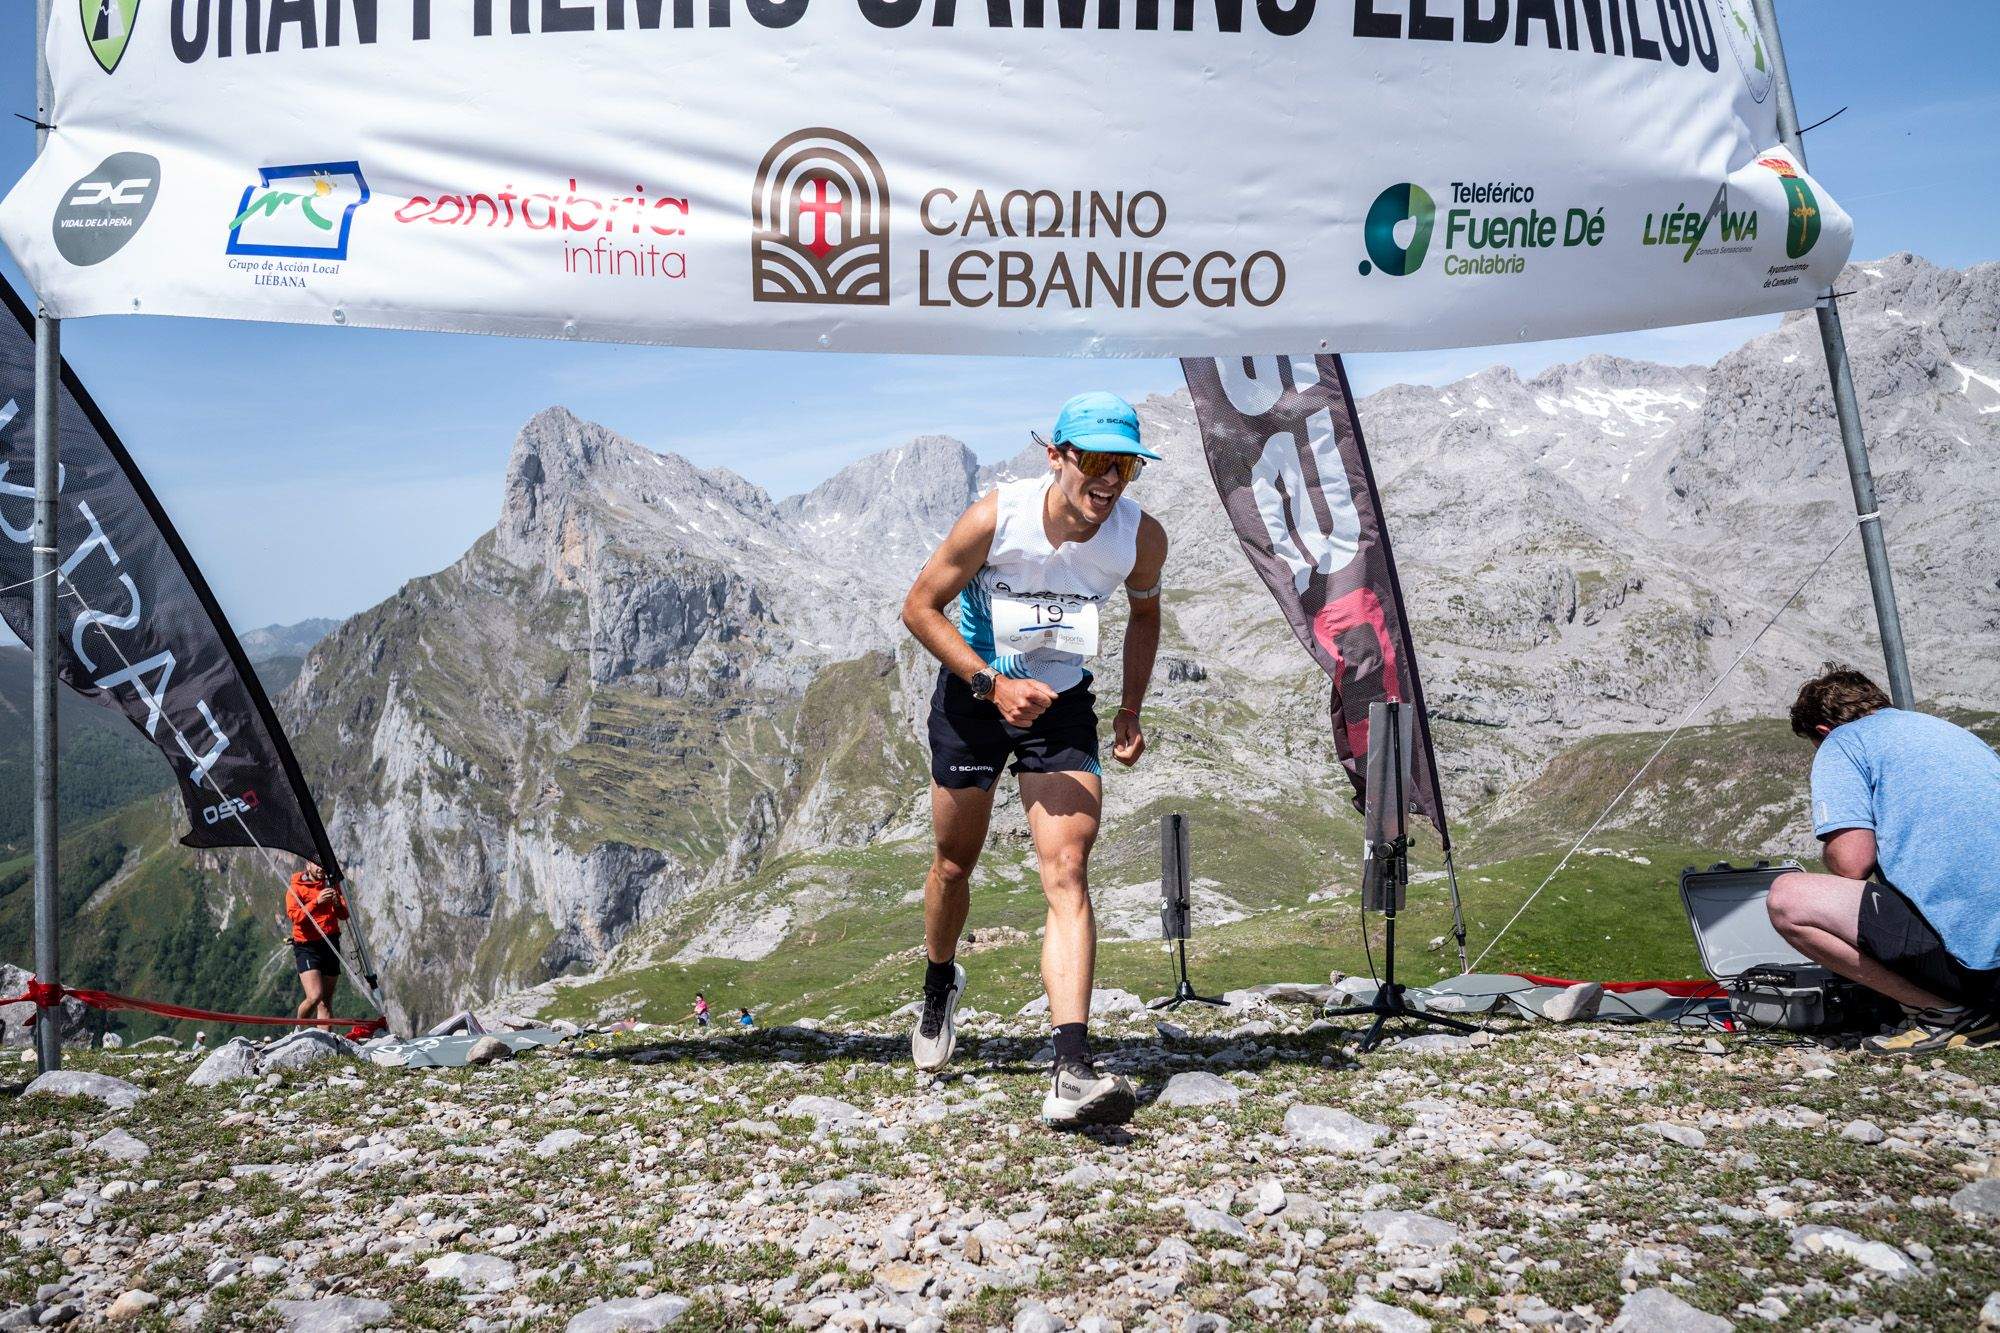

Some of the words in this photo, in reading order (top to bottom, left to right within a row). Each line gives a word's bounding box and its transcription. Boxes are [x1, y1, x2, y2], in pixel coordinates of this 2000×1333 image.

[1450, 181, 1535, 204] Teleférico
[394, 178, 689, 236] cantabria
[919, 187, 1167, 239] CAMINO
[61, 218, 85, 228] VIDAL
[85, 218, 96, 227] DE
[96, 218, 108, 227] LA
[108, 216, 133, 227] PEÑA
[1445, 208, 1557, 250] Fuente
[1563, 206, 1606, 247] Dé
[228, 259, 260, 271] Grupo
[261, 260, 274, 271] de
[275, 261, 310, 273] Acción
[312, 263, 340, 275] Local
[563, 236, 687, 279] infinita
[1444, 253, 1526, 276] Cantabria
[254, 272, 307, 288] LIÉBANA
[918, 249, 1287, 309] LEBANIEGO
[1767, 263, 1809, 277] Ayuntamiento
[1763, 279, 1771, 288] de
[1771, 276, 1799, 288] Camaleño
[1030, 603, 1065, 625] 19
[958, 765, 994, 773] SCARPA
[1061, 1081, 1081, 1094] SCARPA
